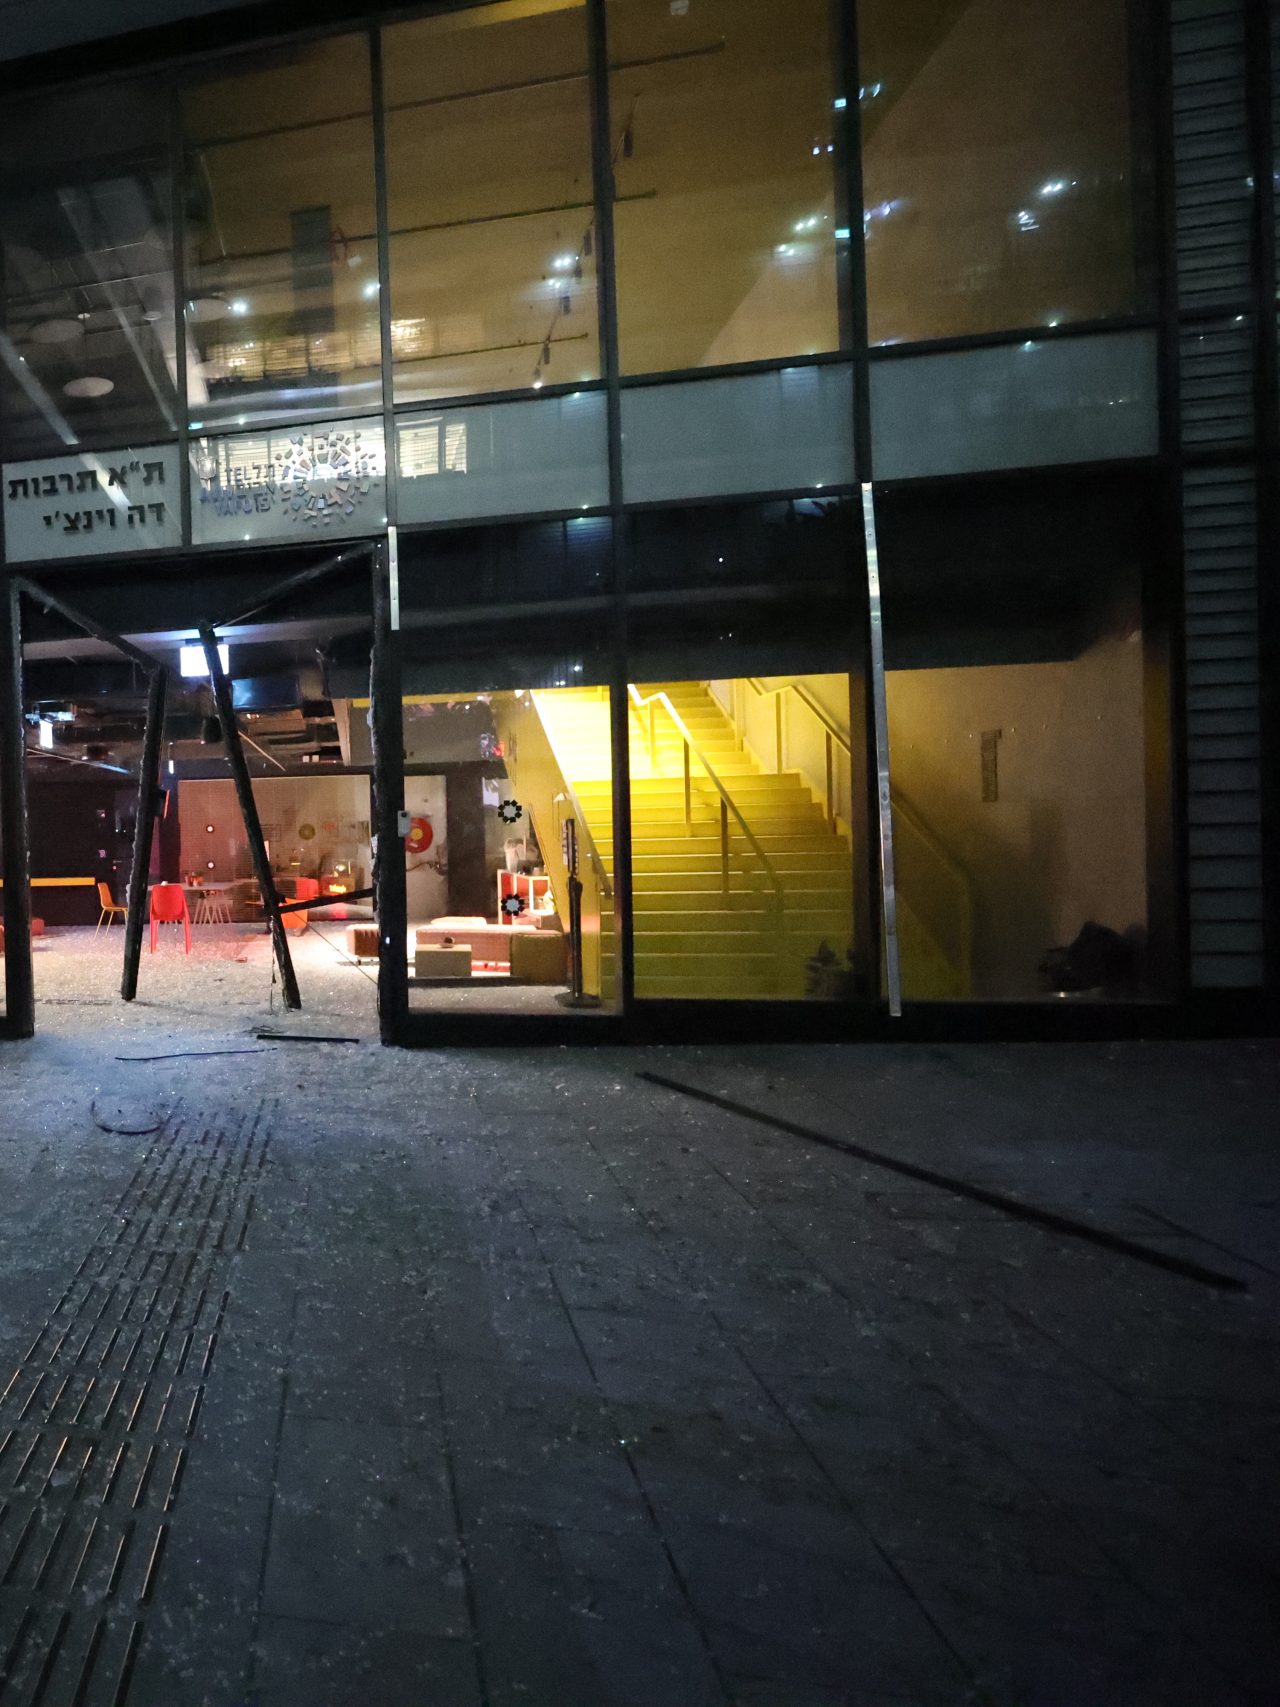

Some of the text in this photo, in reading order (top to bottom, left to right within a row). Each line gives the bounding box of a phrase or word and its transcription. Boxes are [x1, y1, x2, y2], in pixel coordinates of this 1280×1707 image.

[9, 470, 98, 499] תרבות
[43, 502, 165, 531] דה וינצ'י
